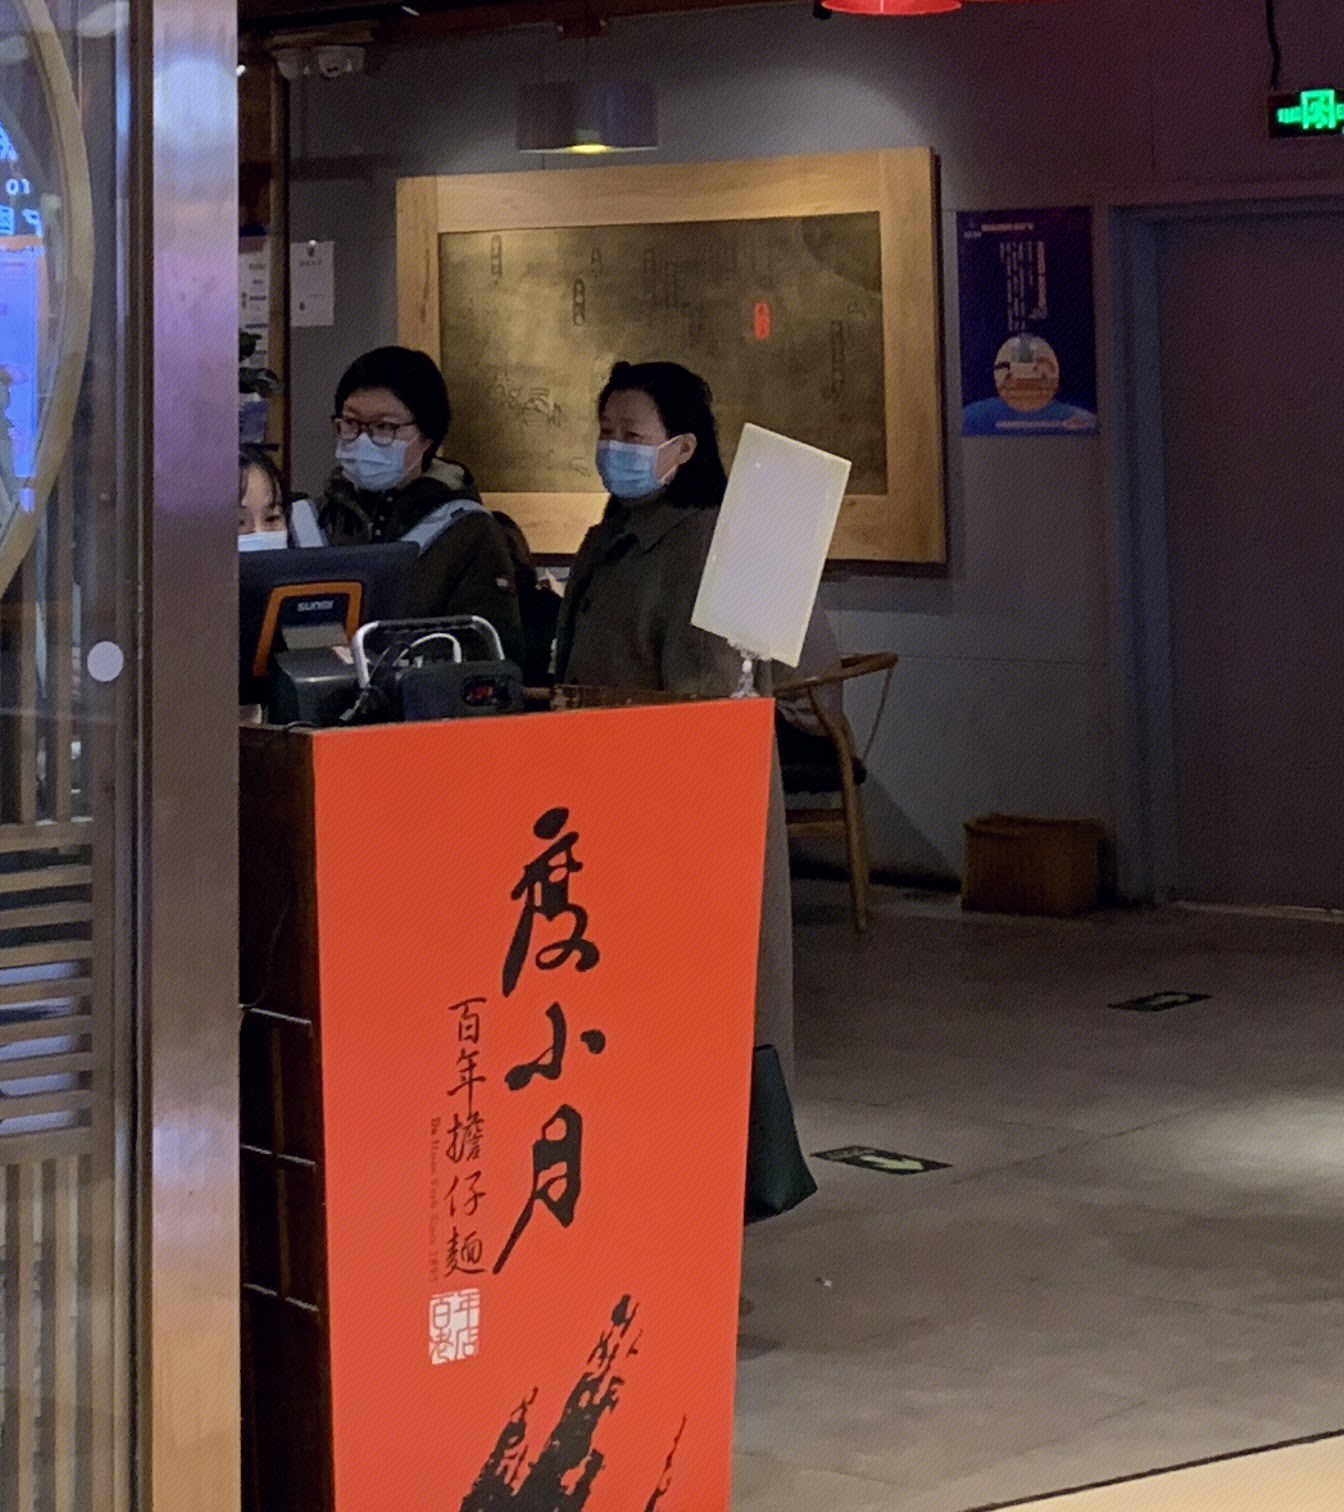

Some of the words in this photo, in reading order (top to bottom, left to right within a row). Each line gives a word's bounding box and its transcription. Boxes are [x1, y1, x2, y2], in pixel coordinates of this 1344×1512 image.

[445, 996, 487, 1277] 百年擔仔麵
[493, 807, 606, 1275] 度小月
